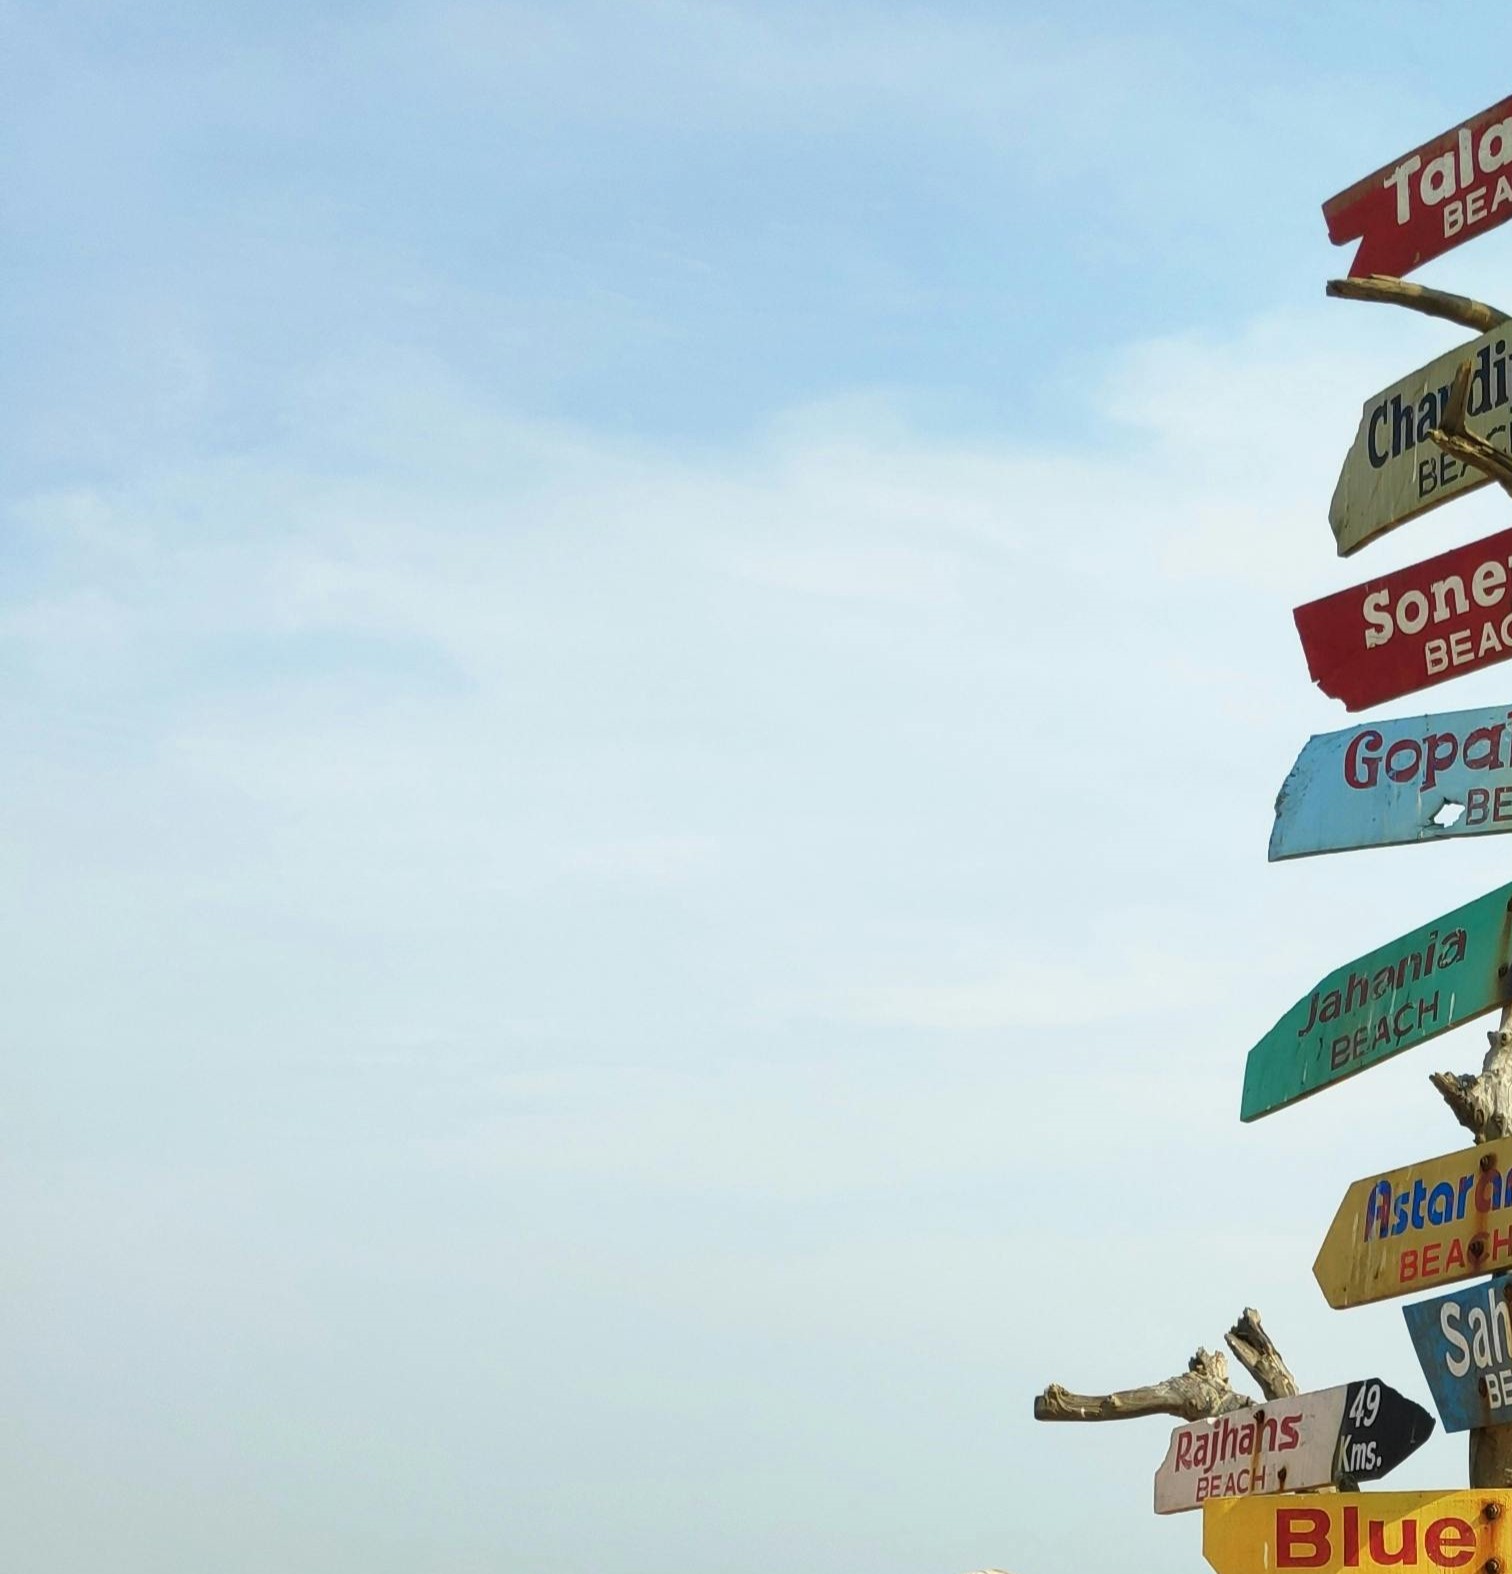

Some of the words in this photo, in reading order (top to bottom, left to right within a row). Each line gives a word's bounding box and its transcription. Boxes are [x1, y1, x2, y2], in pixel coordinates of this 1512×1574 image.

[1298, 928, 1467, 1037] Jahania
[1331, 990, 1439, 1071] BEACH
[1348, 1384, 1381, 1428] 49
[1175, 1413, 1303, 1474] Rajhans
[1339, 1434, 1383, 1473] Kms.
[1196, 1465, 1265, 1501] BEACH
[1276, 1506, 1477, 1568] Blue
